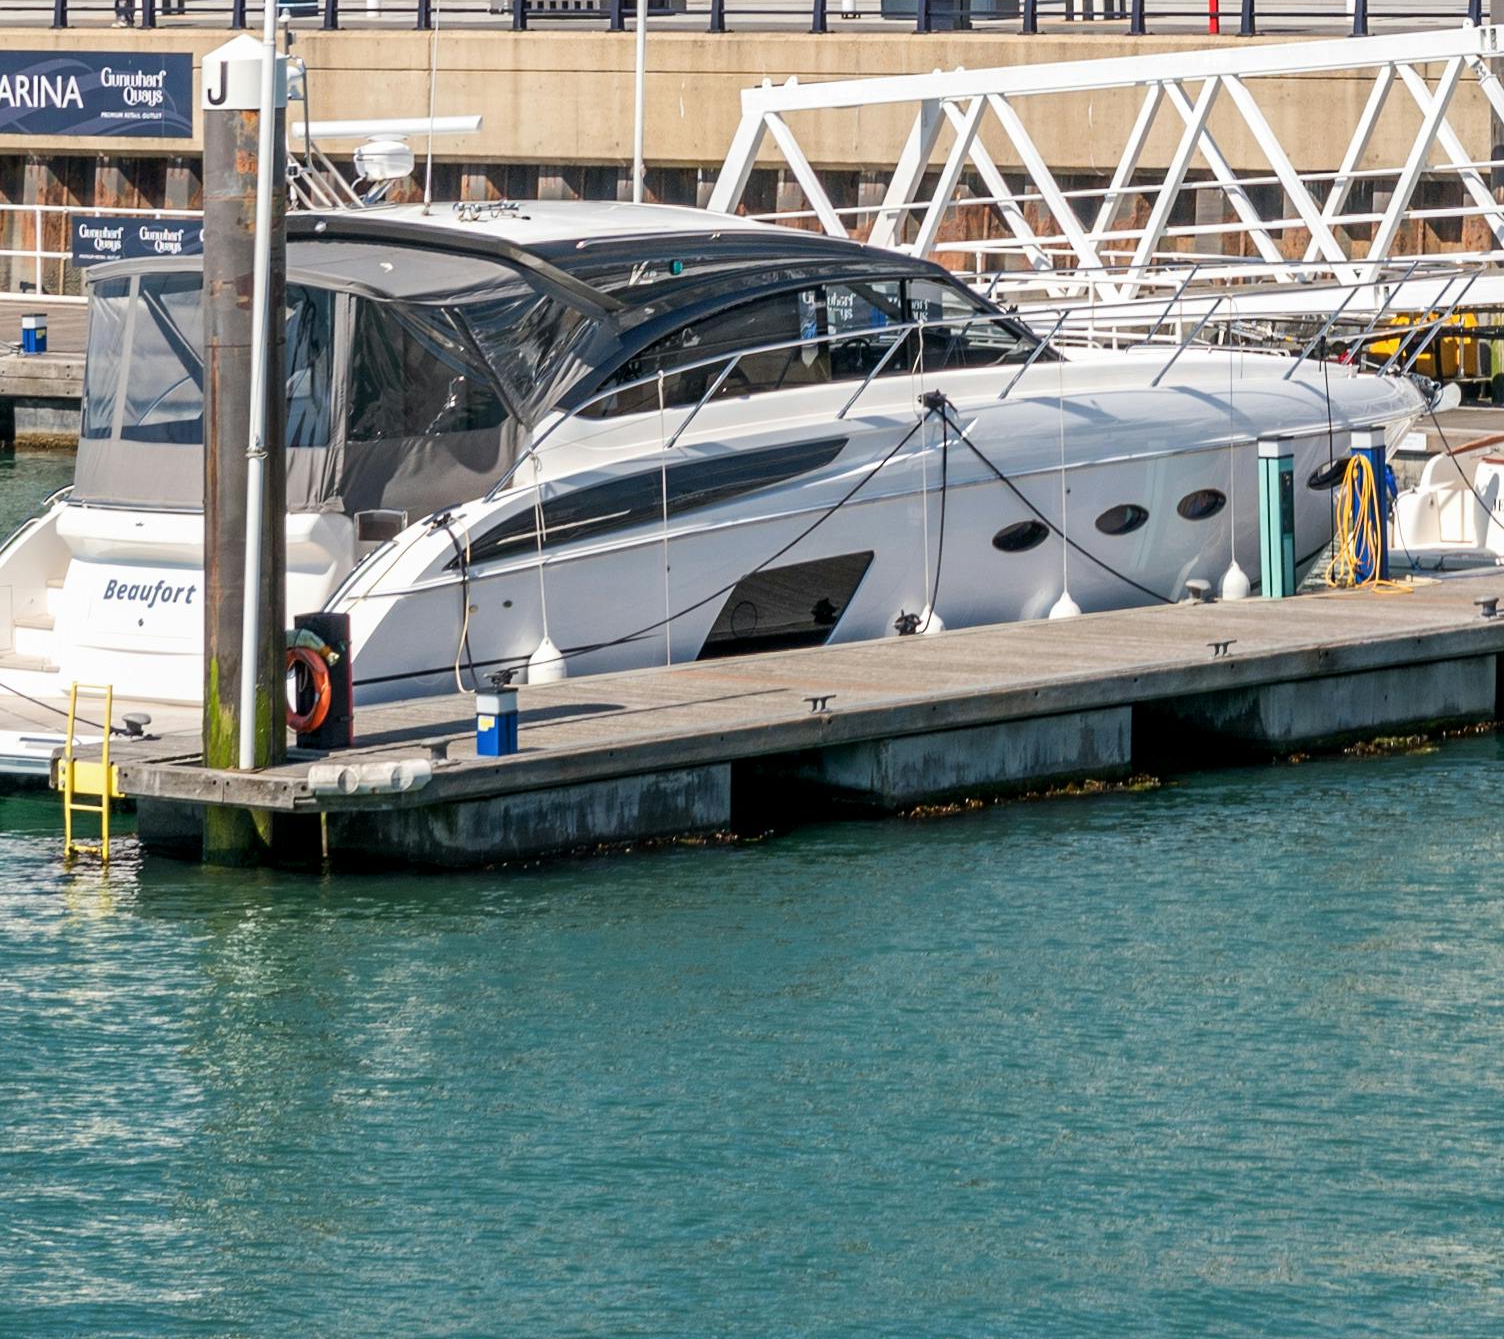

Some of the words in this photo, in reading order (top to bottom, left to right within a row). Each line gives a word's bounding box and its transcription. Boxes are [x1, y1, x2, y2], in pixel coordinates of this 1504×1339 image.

[100, 66, 167, 88] Gunwharf
[207, 59, 228, 105] J
[122, 87, 164, 107] Quays
[79, 224, 124, 241] Gunwharf
[140, 226, 185, 242] Gunwharf
[94, 237, 123, 252] Quays
[155, 240, 183, 254] Quays
[103, 579, 197, 608] Beaufort
